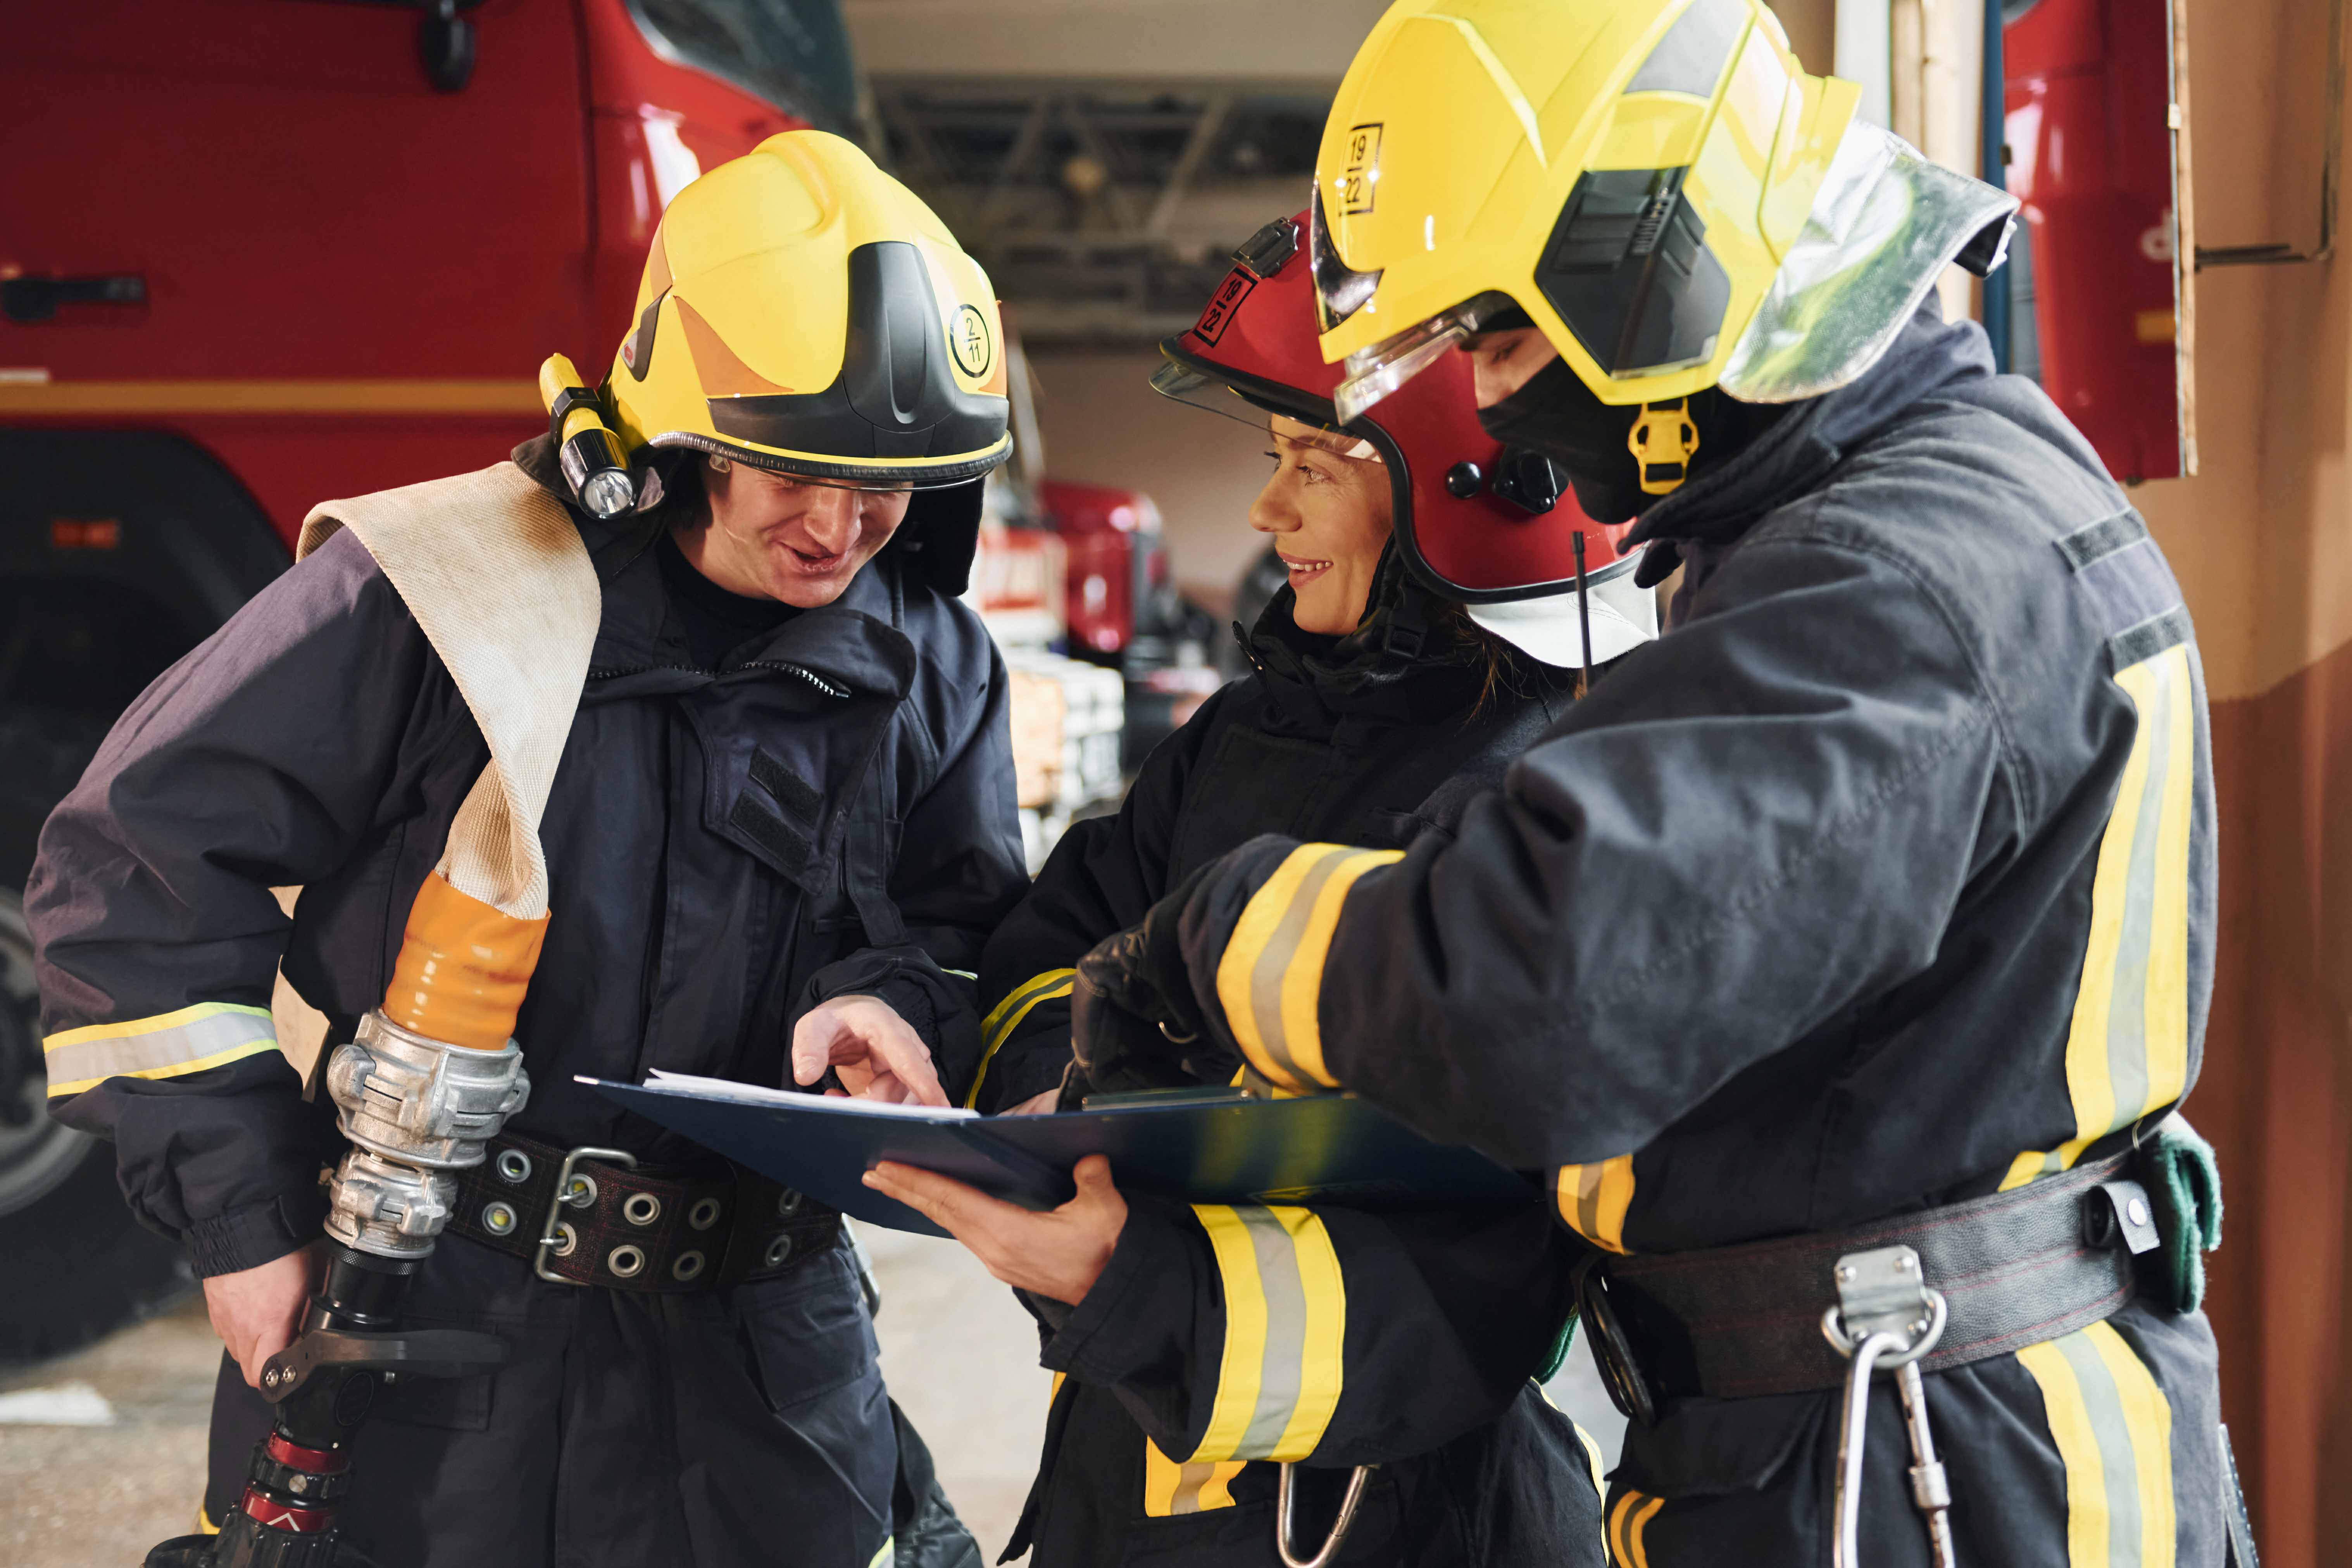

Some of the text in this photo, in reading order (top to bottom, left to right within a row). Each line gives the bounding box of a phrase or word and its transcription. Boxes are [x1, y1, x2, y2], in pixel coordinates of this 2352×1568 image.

[1351, 135, 1366, 161] 19
[1346, 177, 1361, 204] 22
[1222, 278, 1242, 302] 19
[966, 317, 975, 336] 2
[1202, 308, 1221, 333] 22
[969, 342, 980, 362] 11
